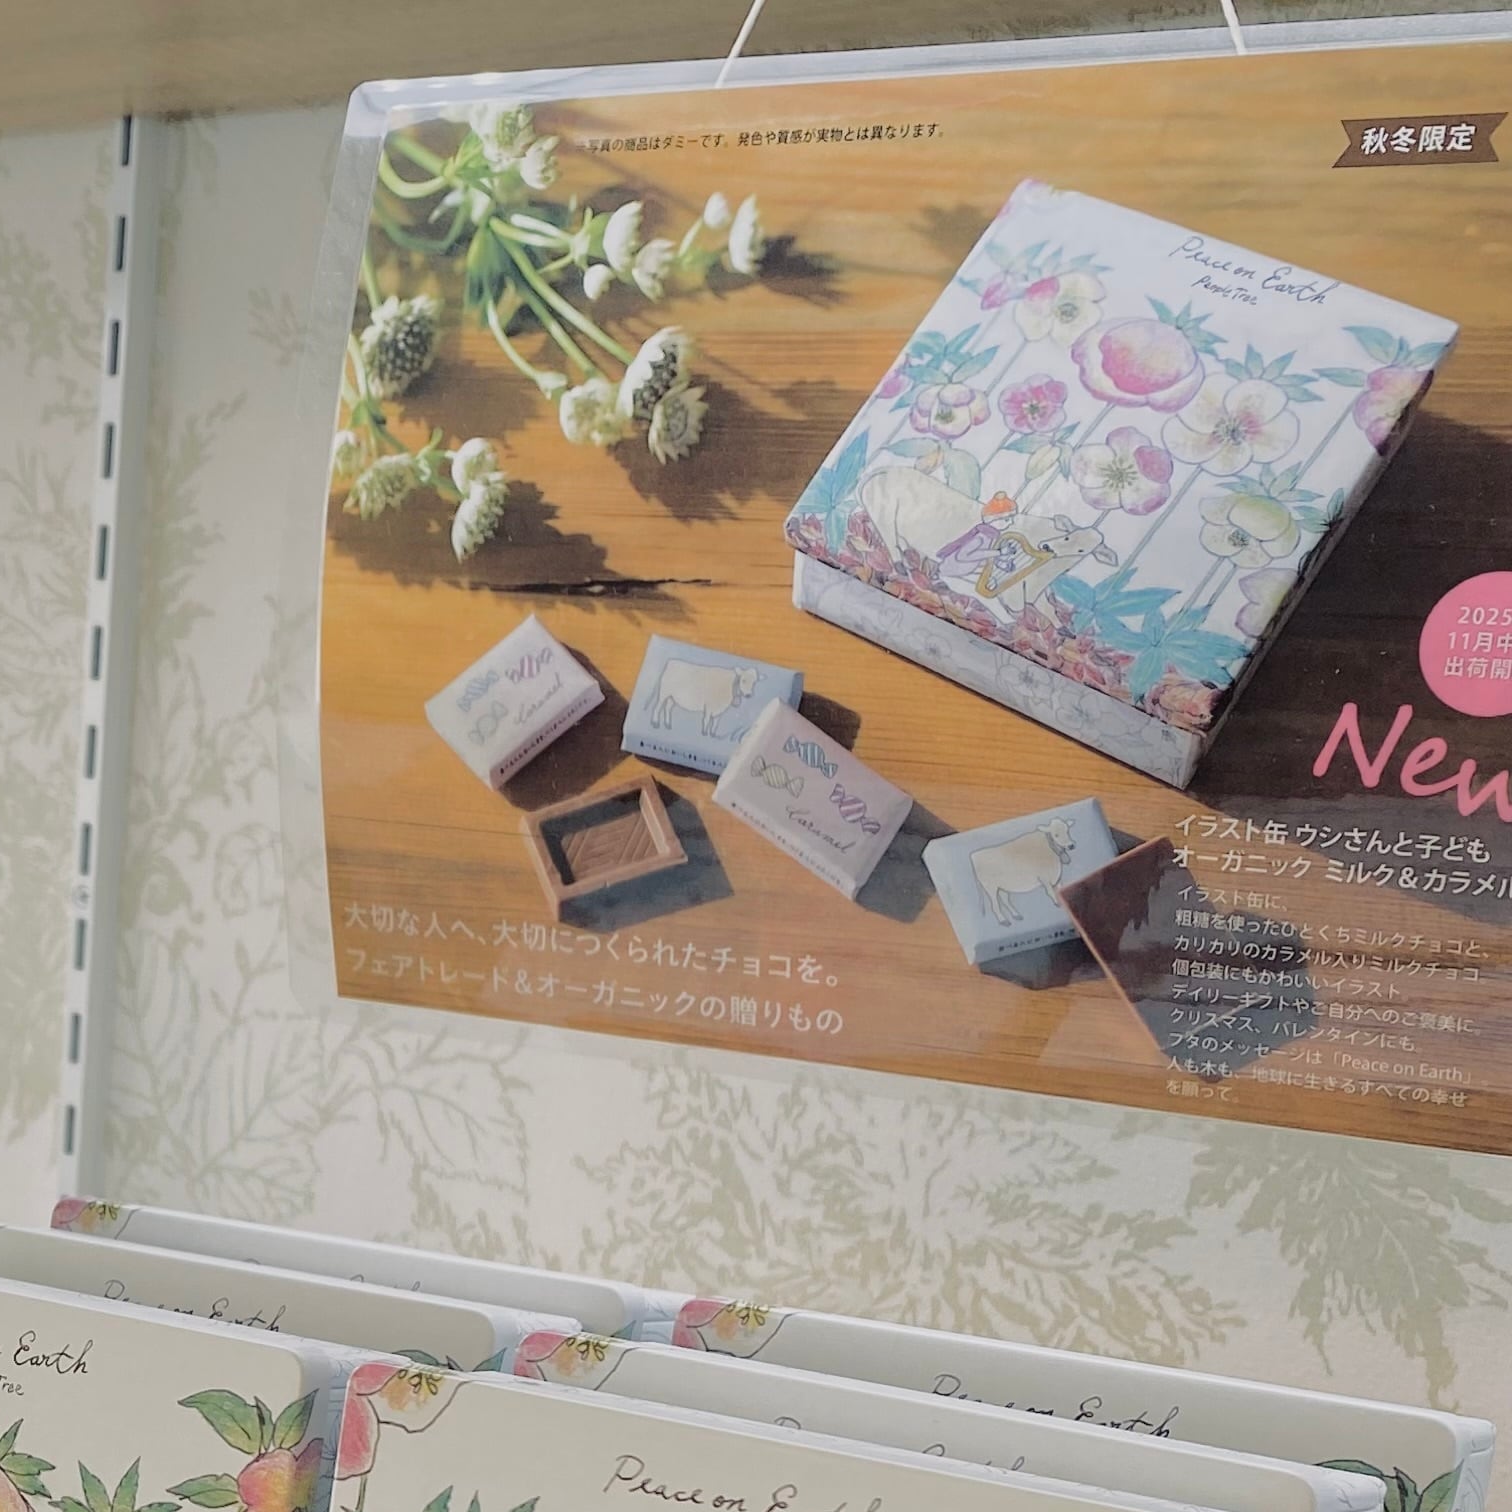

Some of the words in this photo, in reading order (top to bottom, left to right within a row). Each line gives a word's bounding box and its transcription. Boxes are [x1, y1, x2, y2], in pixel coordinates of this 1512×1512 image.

[1361, 123, 1477, 155] 秋冬限定
[1233, 263, 1256, 280] on
[1261, 266, 1342, 305] Earth
[1457, 606, 1512, 626] 2025
[1174, 813, 1289, 846] イラスト缶
[1294, 824, 1491, 864] ウシさんと子ども
[1171, 846, 1312, 879] オーガニック
[1176, 885, 1289, 912] イラスト缶に、
[345, 900, 841, 988] 大切な人へ、大切につくられたチョコを。
[1175, 908, 1491, 959] 粗糖を使ったひとくちミルクチョコと、
[1173, 935, 1487, 985] カリカリのカラメル入りミルクチョコ。
[13, 1330, 95, 1375] Earth
[602, 1454, 703, 1507] Peace
